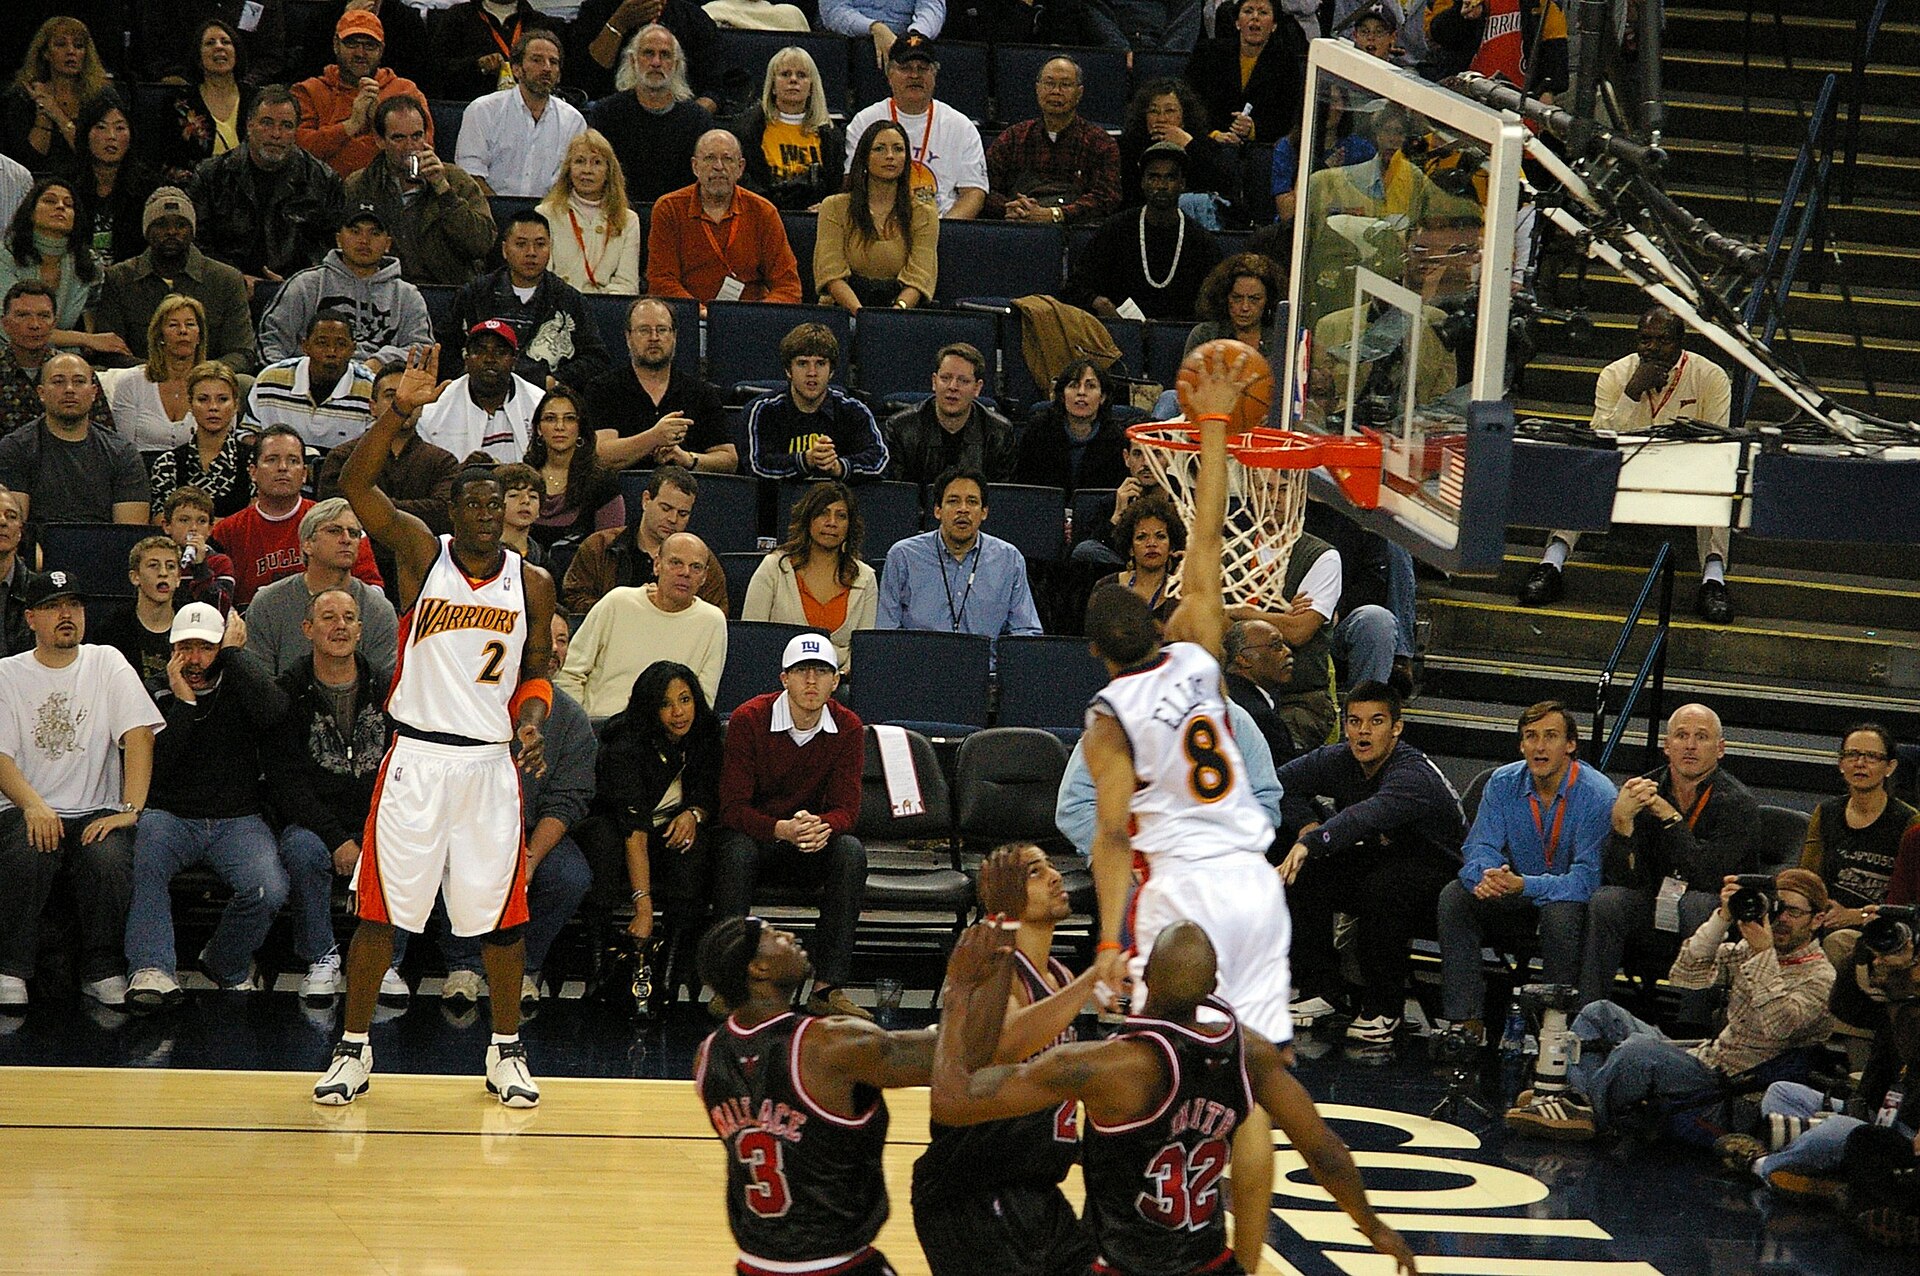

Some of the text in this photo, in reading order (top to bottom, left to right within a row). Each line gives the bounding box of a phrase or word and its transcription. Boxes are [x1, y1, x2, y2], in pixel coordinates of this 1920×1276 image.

[256, 548, 304, 577] BULL
[413, 598, 521, 648] WARRIORS
[475, 640, 507, 685] 2
[1183, 715, 1234, 803] 8
[736, 1127, 792, 1218] 3
[1134, 1138, 1231, 1232] 32
